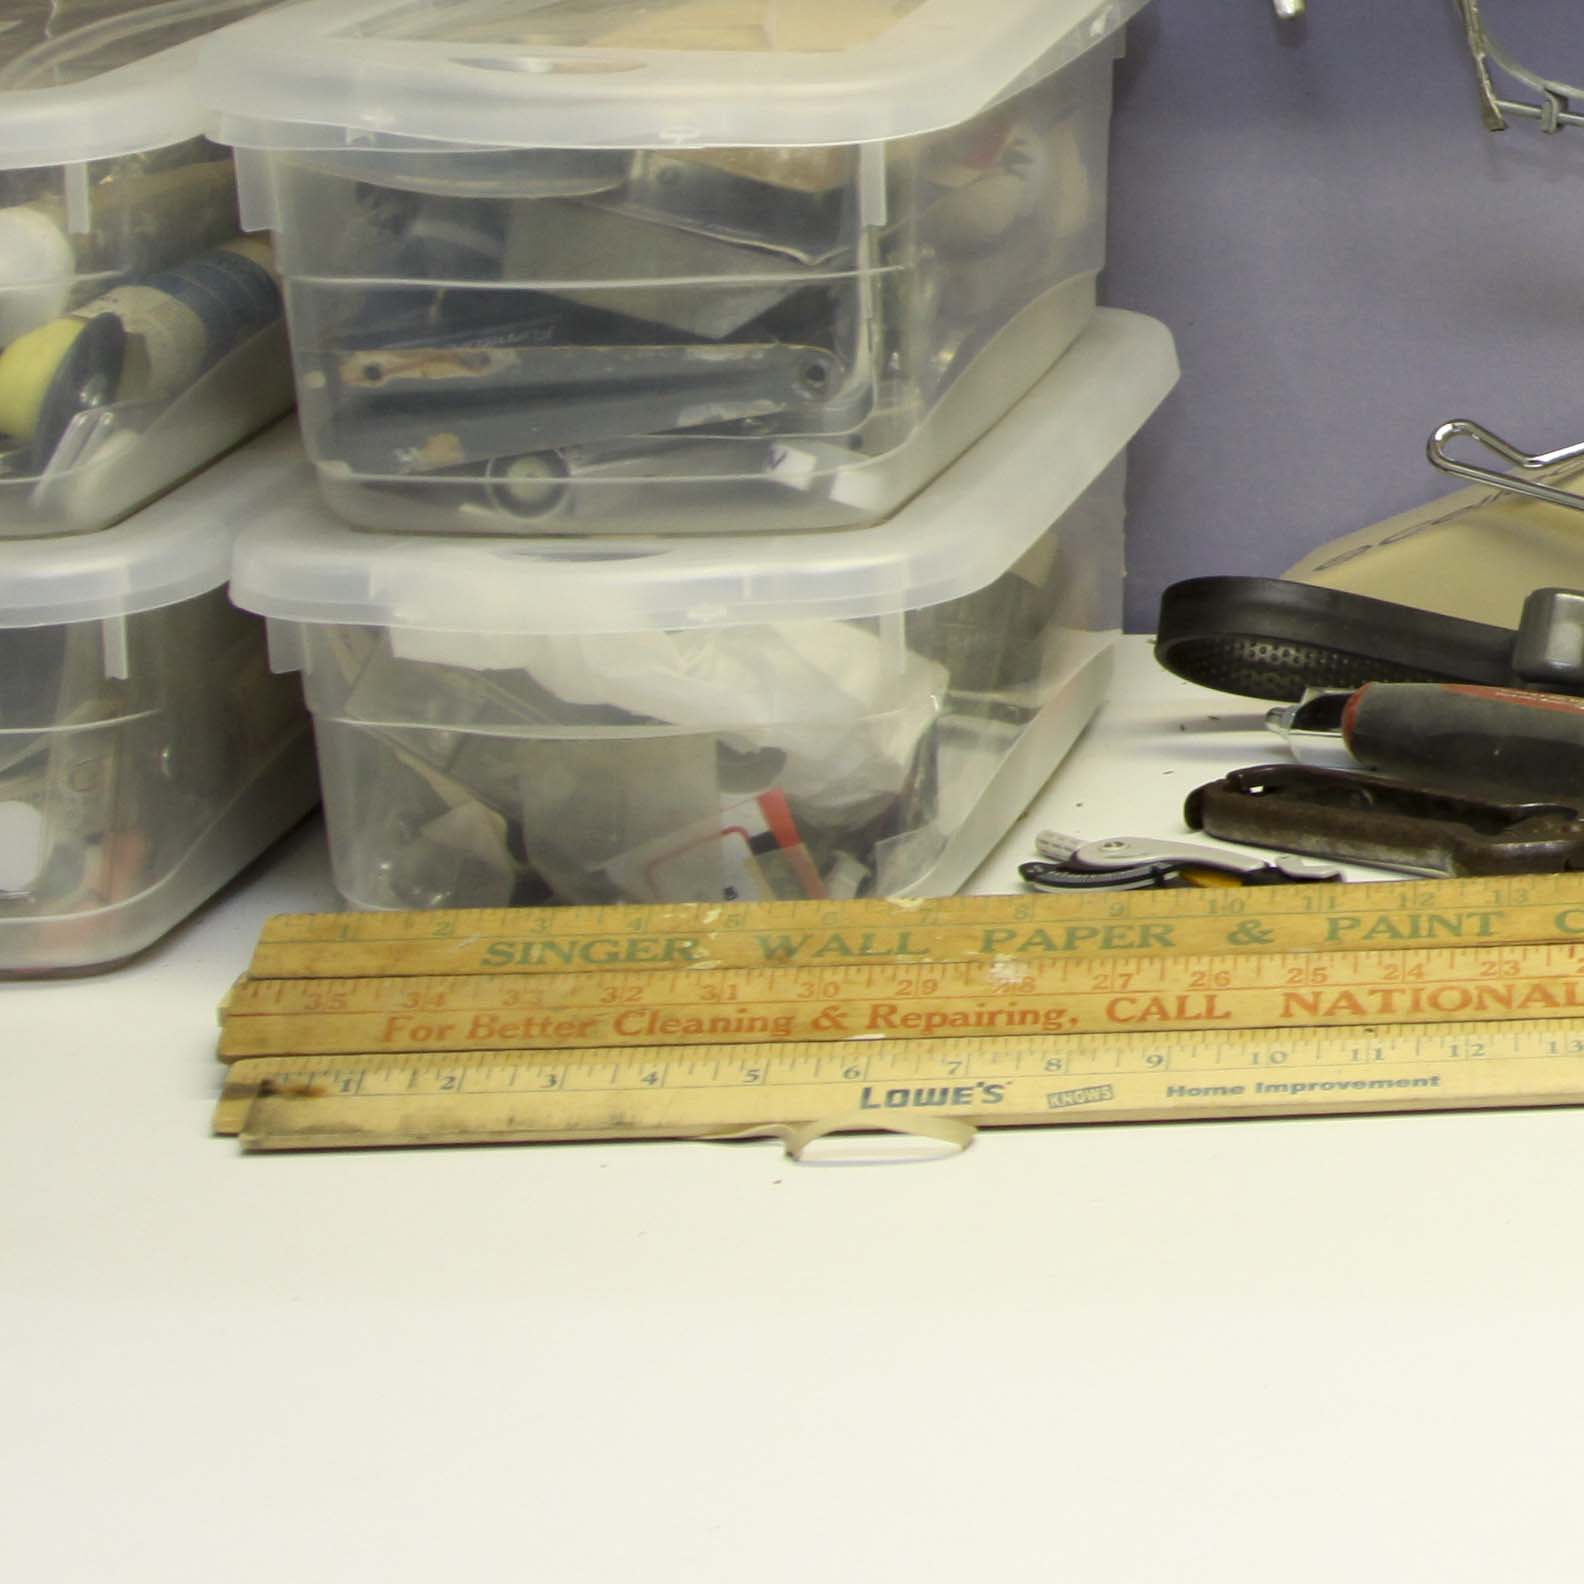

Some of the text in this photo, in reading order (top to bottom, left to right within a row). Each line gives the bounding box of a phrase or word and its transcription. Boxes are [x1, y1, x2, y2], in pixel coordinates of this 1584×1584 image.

[480, 938, 702, 971] SINGER
[756, 928, 931, 963] WALL
[980, 921, 1177, 955] PAPER
[1227, 918, 1275, 947] &
[1325, 910, 1505, 943] PAINT
[380, 1016, 447, 1046] For
[467, 1008, 602, 1044] Better
[611, 1005, 794, 1043] Cleaning
[808, 1005, 850, 1035] &
[866, 996, 1080, 1038] Repairing,
[1105, 993, 1232, 1022] CALL
[859, 1074, 1442, 1111] LOWE'S Home Improvement
